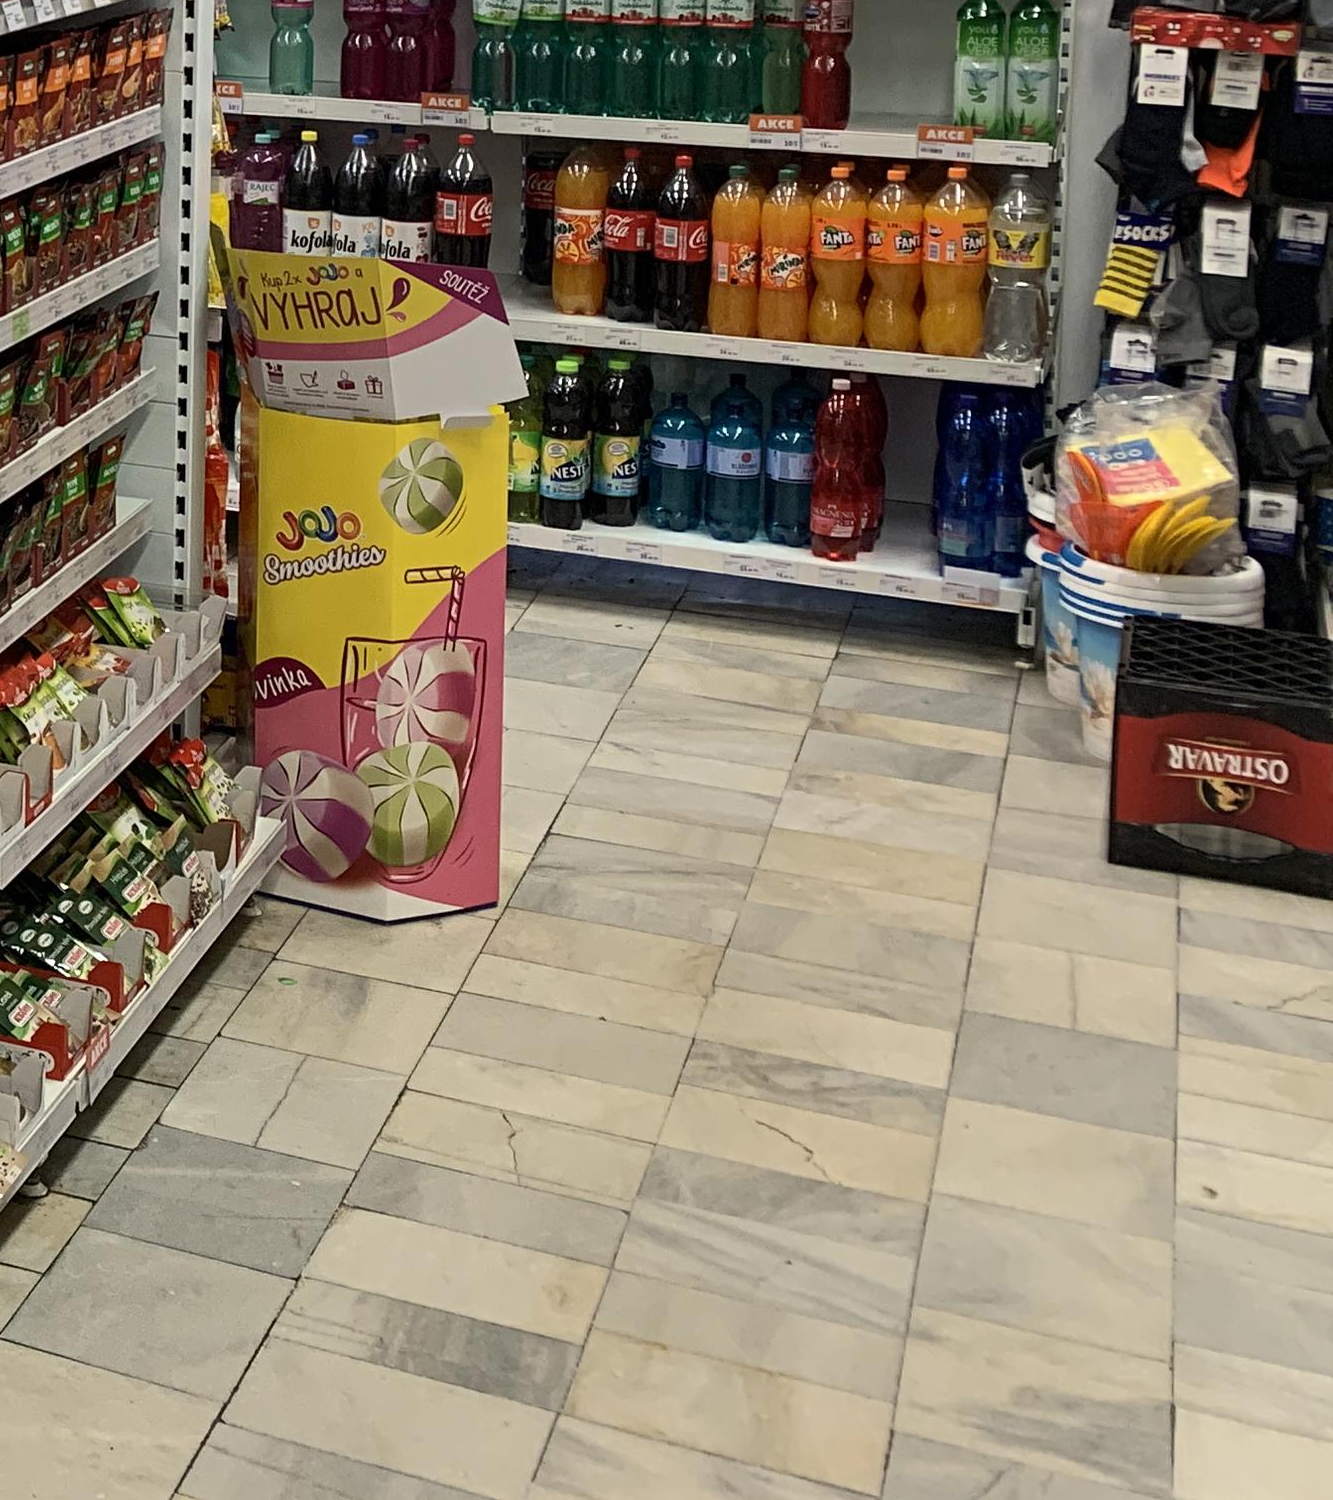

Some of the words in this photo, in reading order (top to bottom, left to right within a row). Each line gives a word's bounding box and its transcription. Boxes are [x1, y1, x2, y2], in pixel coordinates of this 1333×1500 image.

[966, 34, 999, 47] ALOE
[1015, 34, 1049, 47] ALOE
[429, 95, 462, 108] AKCE
[758, 117, 794, 130] AKCE
[926, 129, 965, 142] AKCE
[249, 181, 277, 195] RAJEC
[290, 228, 333, 253] kofola
[819, 231, 854, 249] FANTA
[260, 272, 284, 292] Kup
[355, 267, 365, 278] a
[438, 268, 492, 305] SOUTĚŽ
[249, 287, 384, 332] VYHRAJ
[275, 505, 362, 552] JOJO
[263, 543, 387, 585] Smoothies
[1166, 741, 1290, 786] OSTRAVAR
